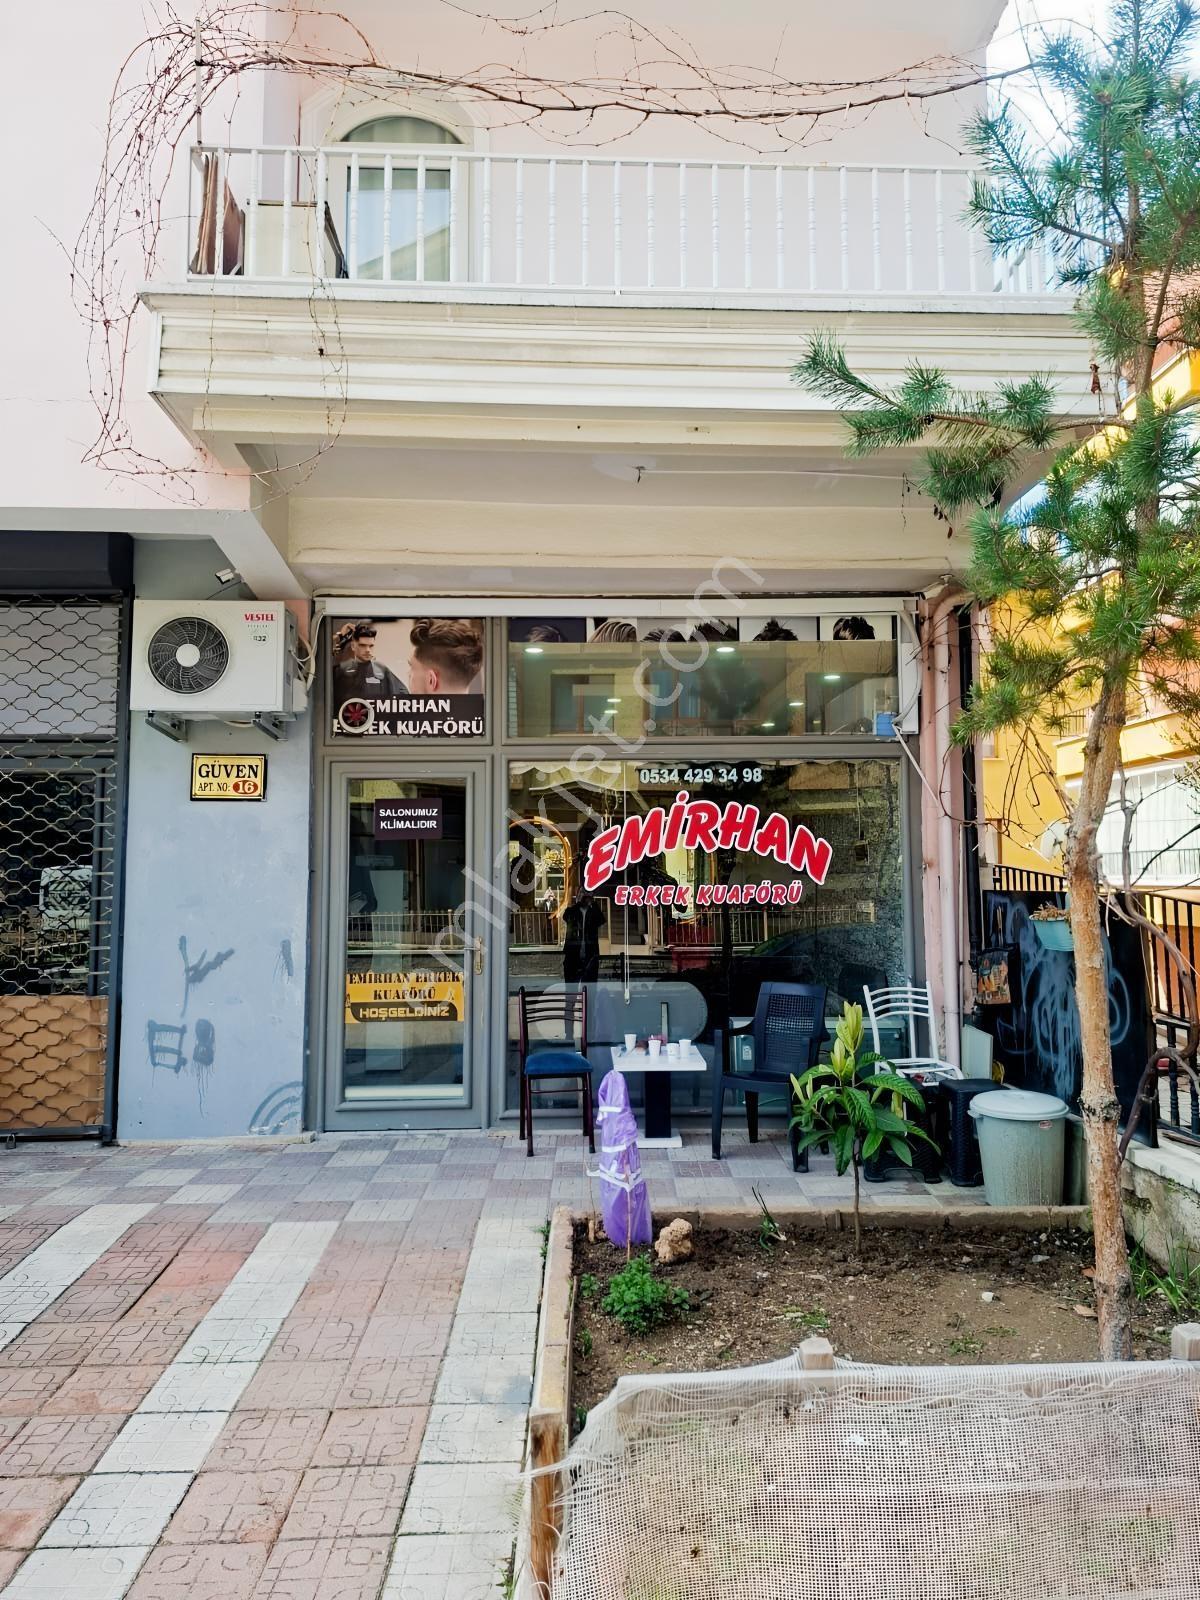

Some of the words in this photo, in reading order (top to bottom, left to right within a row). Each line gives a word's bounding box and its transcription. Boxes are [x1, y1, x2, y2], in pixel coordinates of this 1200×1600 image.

[244, 613, 275, 621] VESTEL
[333, 718, 392, 735] EEK
[396, 716, 484, 735] KUAFÖRÜ
[198, 760, 260, 779] GÜVEN
[640, 769, 680, 784] 0534
[683, 768, 714, 783] 429
[718, 767, 738, 783] 34
[742, 767, 763, 783] 98
[198, 782, 215, 792] APT.
[237, 781, 255, 793] 16
[379, 808, 438, 817] SALONUMUZ
[380, 818, 438, 829] KLİMALIDIR
[584, 790, 833, 891] EMİRHAN
[615, 884, 691, 906] ERKEK
[696, 880, 803, 906] KUAFÖRÜ
[415, 971, 461, 983] ERKEK
[373, 987, 436, 1001] KUAFÖRÜ
[359, 1002, 450, 1021] HOŞGELDİNİZ
